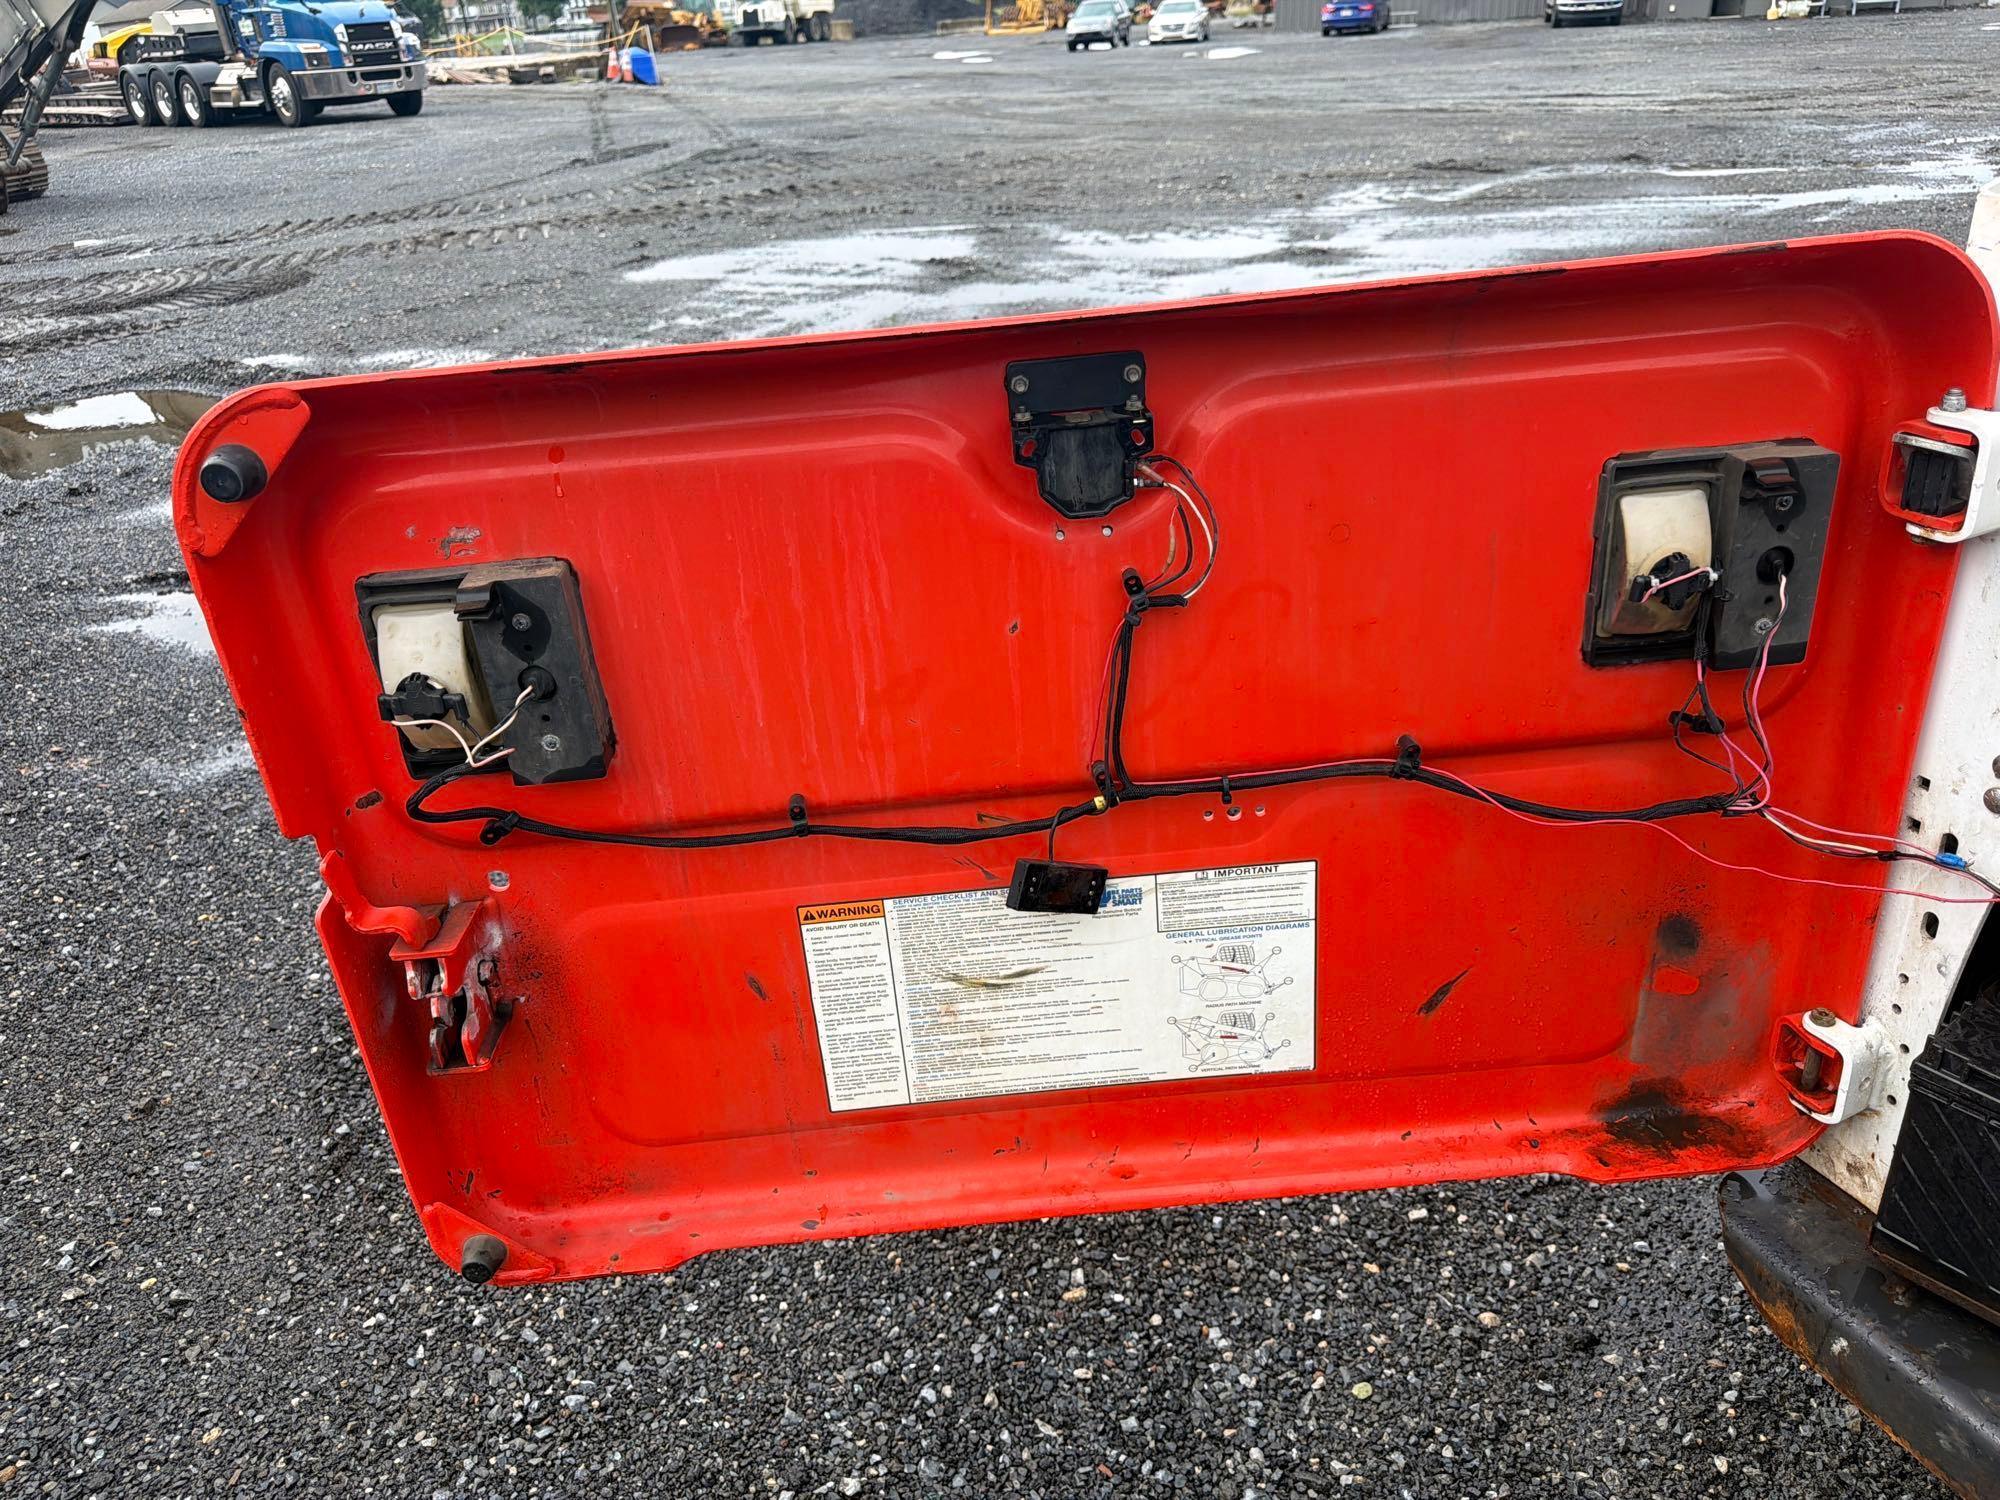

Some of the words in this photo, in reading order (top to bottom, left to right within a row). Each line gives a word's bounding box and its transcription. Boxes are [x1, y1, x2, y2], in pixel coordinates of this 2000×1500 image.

[350, 41, 394, 51] MACK
[1214, 865, 1279, 877] IMPORTANT
[892, 897, 921, 905] SERVICE
[922, 892, 979, 903] CHECKLIST
[1112, 898, 1142, 907] SMART
[816, 904, 881, 919] WARNING
[1166, 930, 1204, 939] GENERAL
[1207, 925, 1263, 936] LUBRICATION
[1265, 920, 1310, 931] DIAGRAMS
